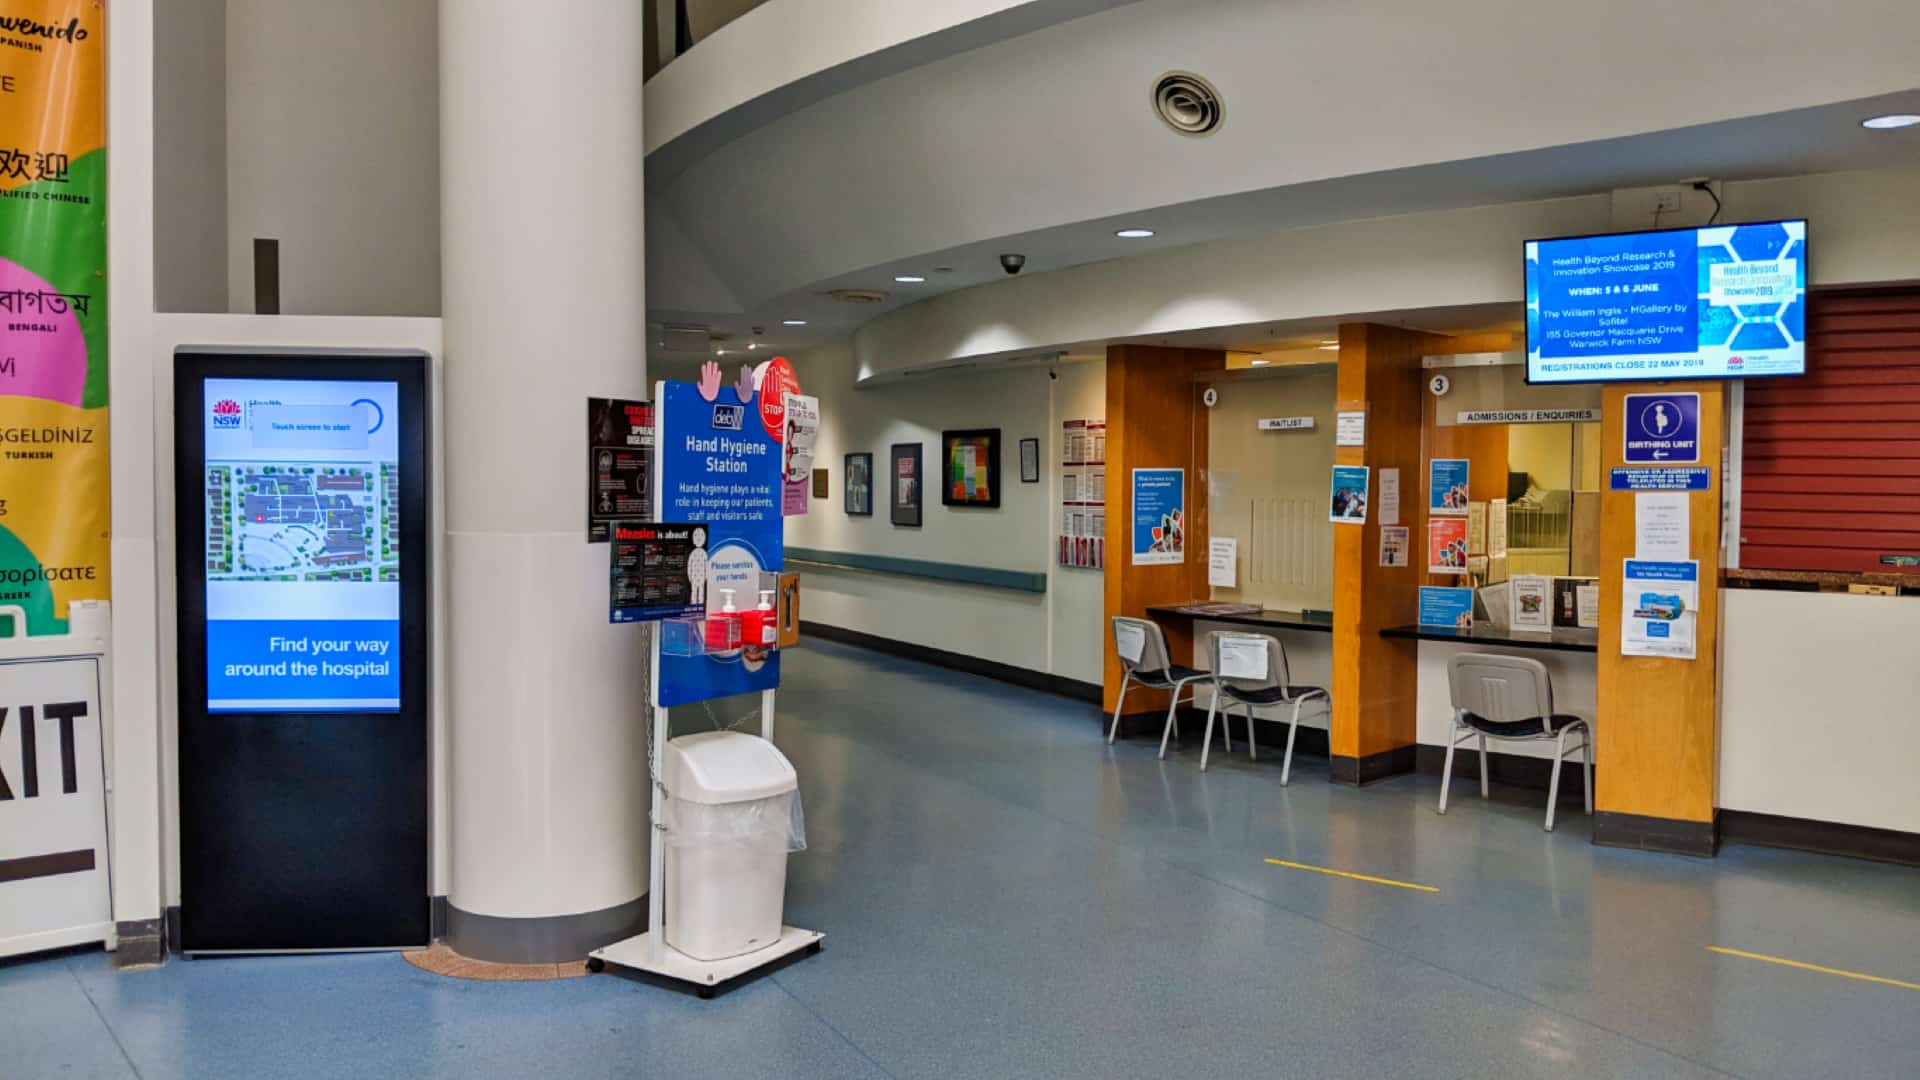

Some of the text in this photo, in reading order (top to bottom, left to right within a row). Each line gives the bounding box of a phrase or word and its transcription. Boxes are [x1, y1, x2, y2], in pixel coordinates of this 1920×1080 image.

[43, 192, 89, 205] CHINESE
[1553, 250, 1676, 266] Health Beyond Research &
[1603, 263, 1650, 273] Showcase
[1653, 260, 1676, 271] 2019
[1569, 287, 1602, 297] WHEN:
[1632, 283, 1659, 293] JUNE
[1543, 310, 1561, 319] The
[1675, 303, 1688, 314] by
[8, 323, 57, 333] BENGALI
[1599, 317, 1628, 327] Sofitel
[1563, 328, 1606, 339] Governor
[1608, 326, 1656, 338] Macquarie
[1658, 325, 1685, 334] Drive
[1569, 336, 1662, 349] Warwick Farm NSW
[1541, 361, 1613, 373] REGISTRATIONS
[1615, 360, 1646, 370] CLOSE
[1661, 359, 1680, 368] MAY
[1433, 378, 1444, 392] 3
[1206, 391, 1213, 403] 4
[765, 404, 784, 416] STOP
[1467, 412, 1528, 421] ADMISSIONS
[1536, 410, 1593, 420] ENQUIRIES
[213, 416, 241, 426] NSW
[271, 422, 295, 431] Touch
[323, 423, 332, 431] to
[332, 423, 351, 431] start
[686, 435, 767, 457] Hand Hygiene
[1628, 440, 1695, 449] BIRTHING UNIT
[5, 451, 54, 460] TURKISH
[706, 456, 748, 473] Station
[679, 482, 700, 493] Hand
[701, 482, 729, 496] hygiene
[730, 483, 749, 496] plays
[675, 497, 690, 507] role
[692, 498, 700, 507] in
[700, 497, 730, 509] keeping
[731, 498, 744, 507] our
[687, 509, 763, 521] staff and visitors safe
[615, 528, 655, 539] Measles
[657, 529, 663, 539] is
[716, 573, 729, 582] your
[269, 636, 389, 656] Find your way
[224, 661, 389, 679] around the hospital
